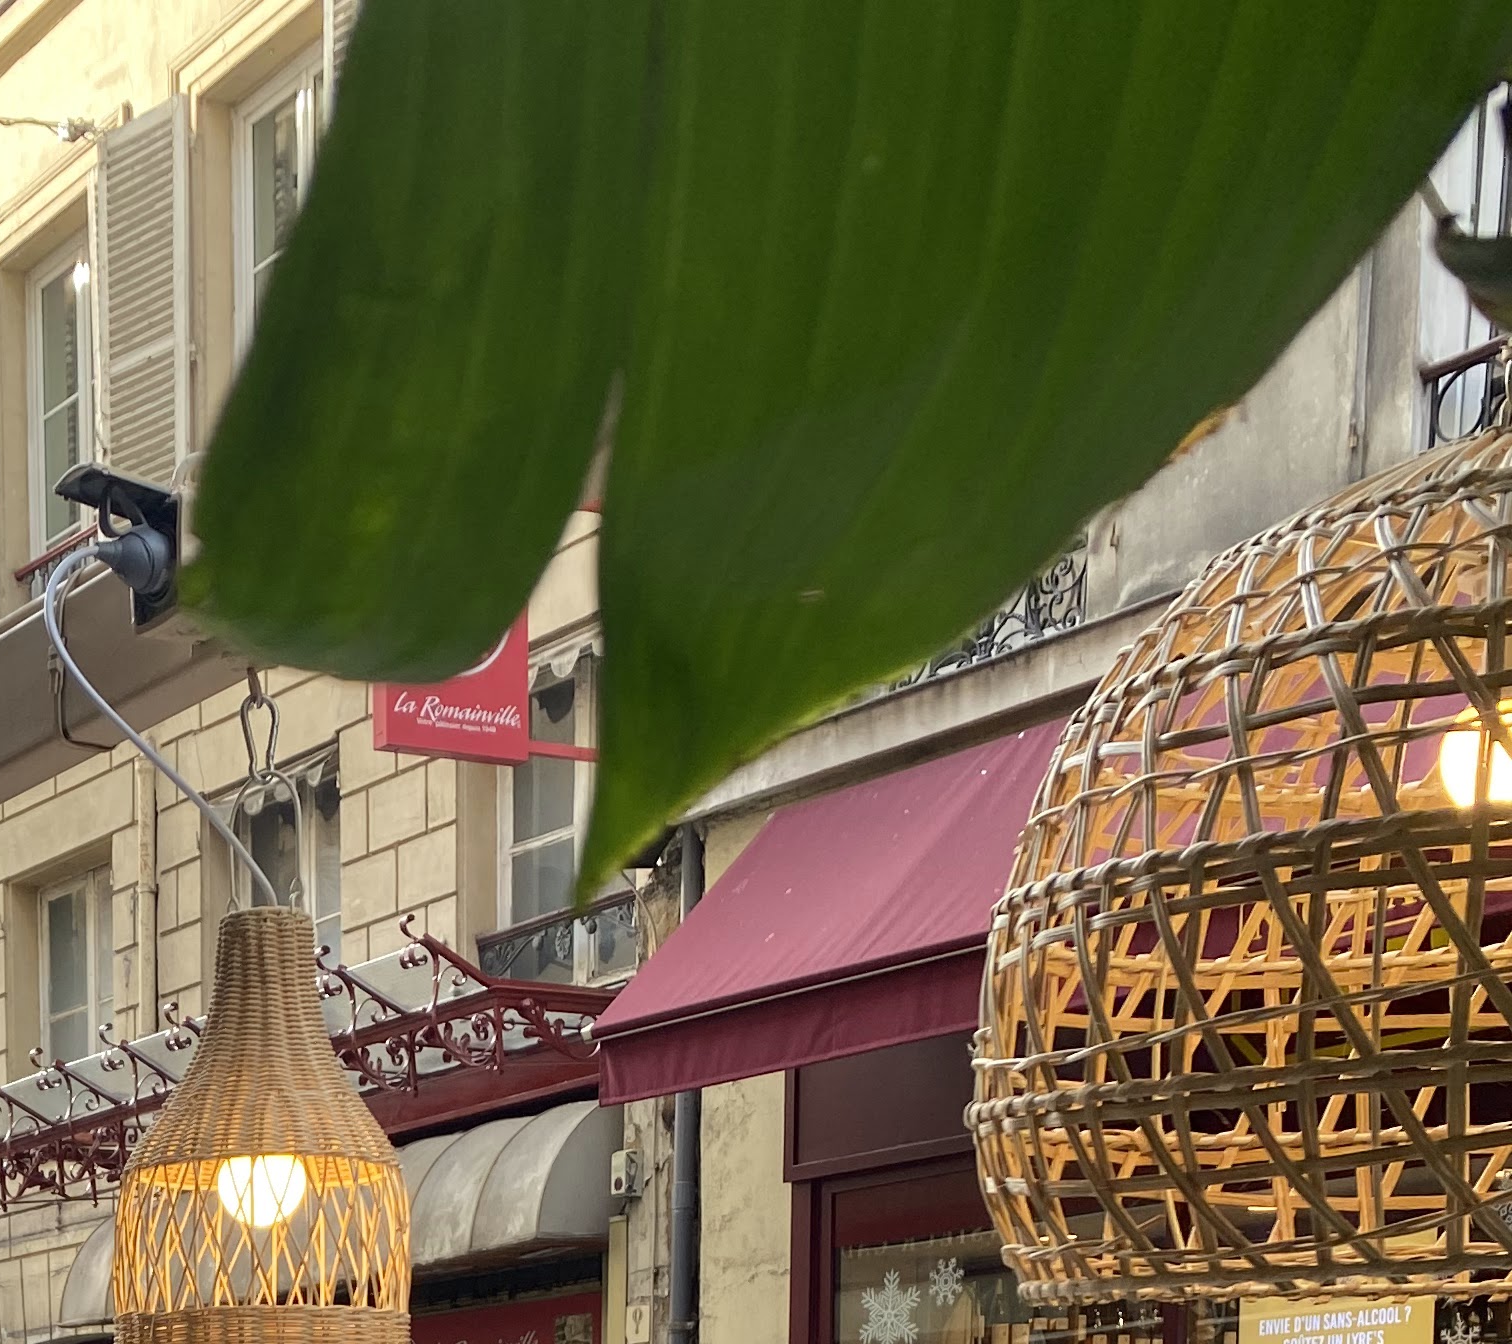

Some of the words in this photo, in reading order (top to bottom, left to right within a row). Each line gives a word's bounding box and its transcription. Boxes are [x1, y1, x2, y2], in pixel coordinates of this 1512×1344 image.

[394, 691, 417, 713] La
[420, 696, 520, 727] Romainville
[1259, 1317, 1290, 1336] ENVIE
[1294, 1314, 1320, 1332] D'UN
[1323, 1307, 1401, 1330] SANS-ALCOOL
[1405, 1306, 1412, 1323] ?
